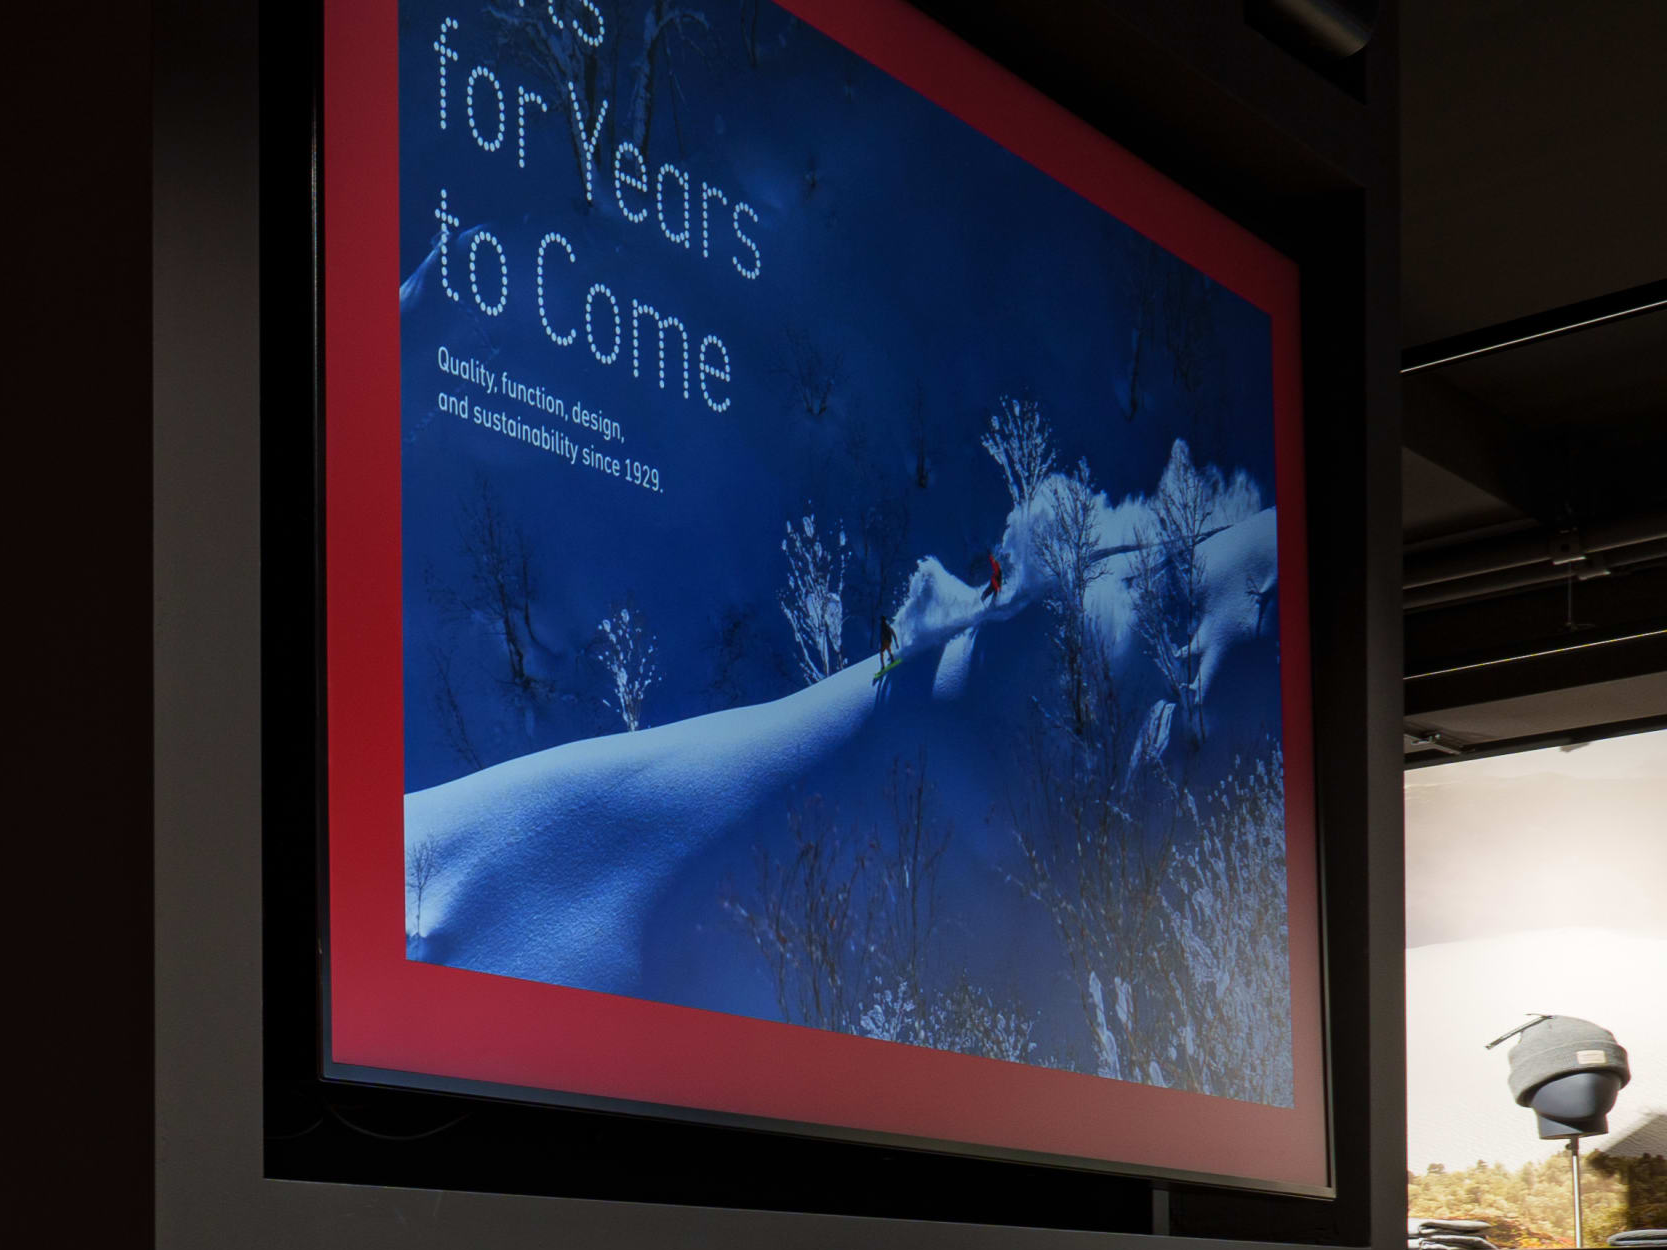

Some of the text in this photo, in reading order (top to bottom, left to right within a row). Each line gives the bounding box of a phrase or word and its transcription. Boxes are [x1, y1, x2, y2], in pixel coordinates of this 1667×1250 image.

[433, 17, 762, 280] for Years
[434, 189, 732, 413] to Come
[437, 346, 626, 444] Quality, function, design,
[438, 392, 664, 493] and sustainability since 1929.
